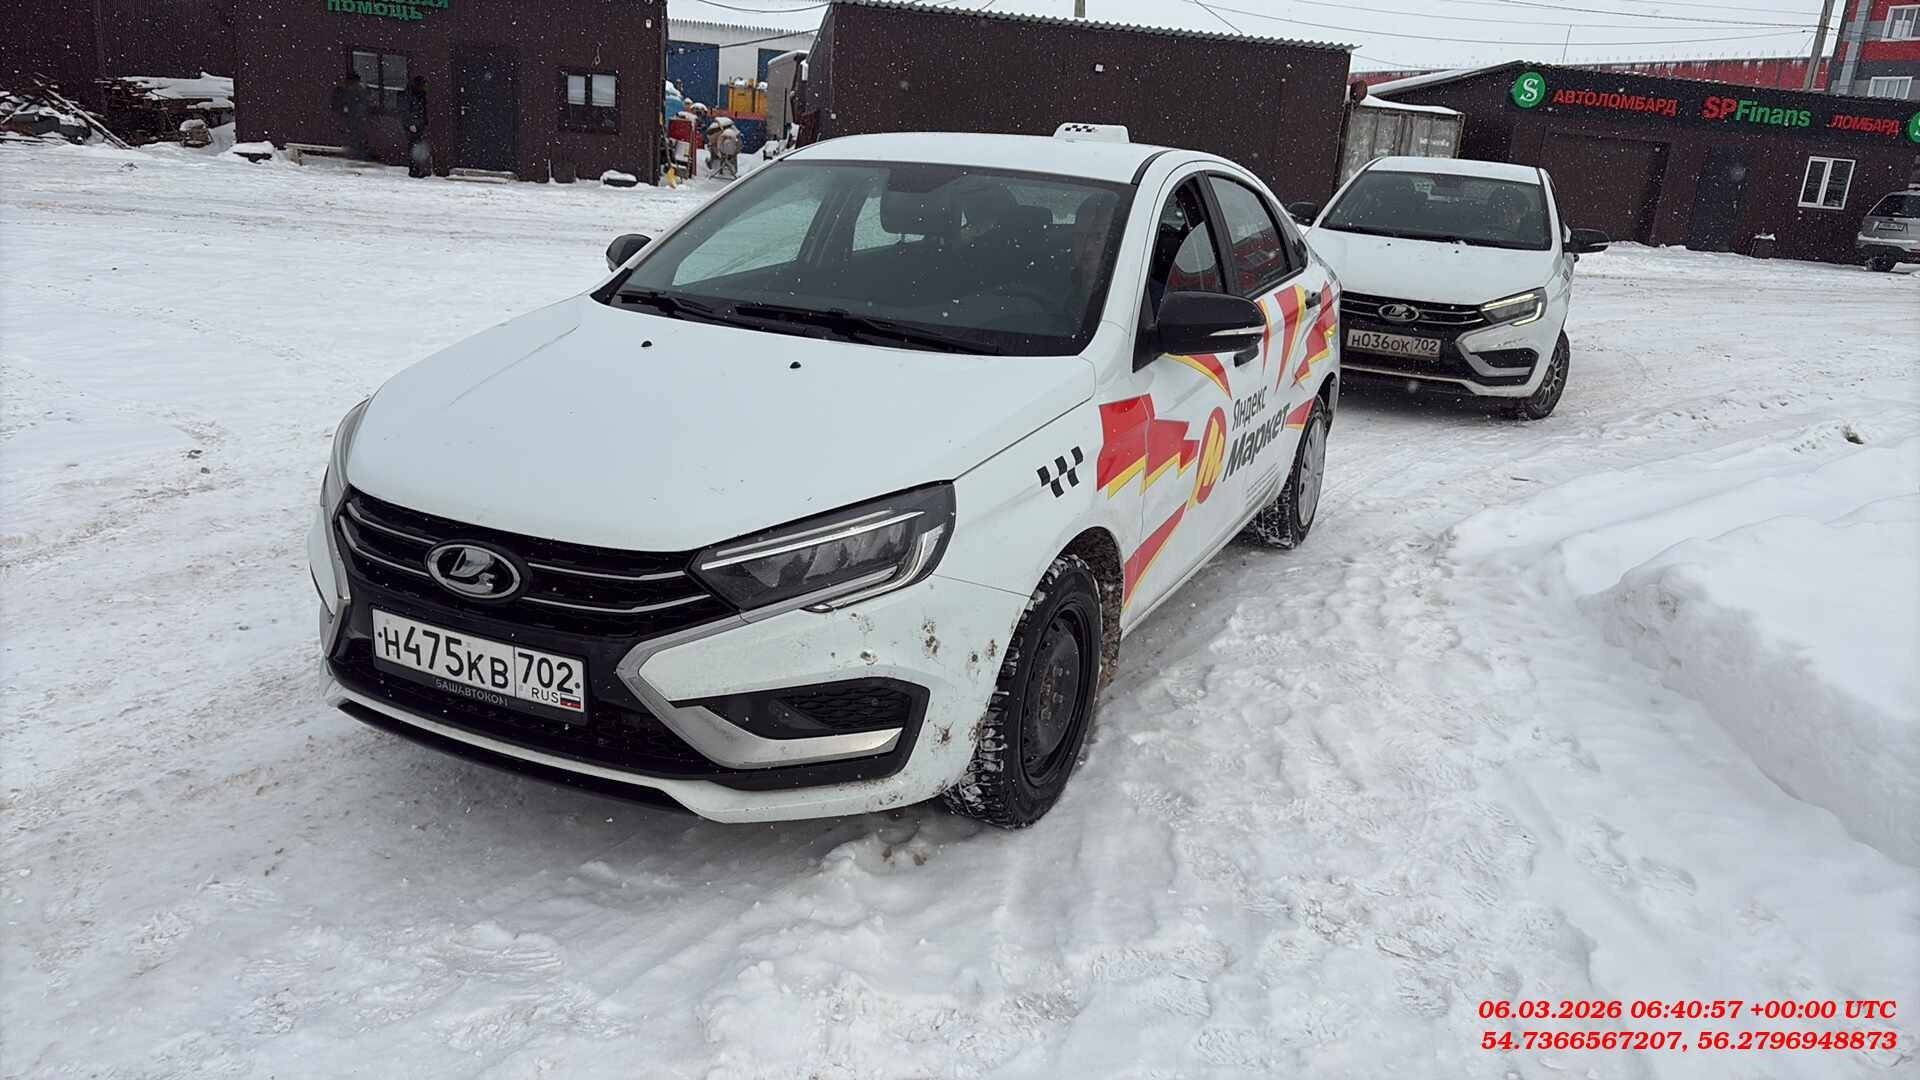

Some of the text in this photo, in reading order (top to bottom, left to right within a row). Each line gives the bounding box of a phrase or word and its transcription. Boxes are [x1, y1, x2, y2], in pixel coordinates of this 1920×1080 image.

[1552, 88, 1678, 117] АВТОЛОМБАРД
[1703, 95, 1812, 127] SPFinans
[1829, 113, 1900, 135] ЛОМБАРД
[1414, 339, 1438, 352] 702
[1232, 386, 1267, 431] Яндекс
[1222, 403, 1291, 482] Маркет
[383, 626, 574, 694] Н475КВ 702
[531, 687, 559, 704] RUS
